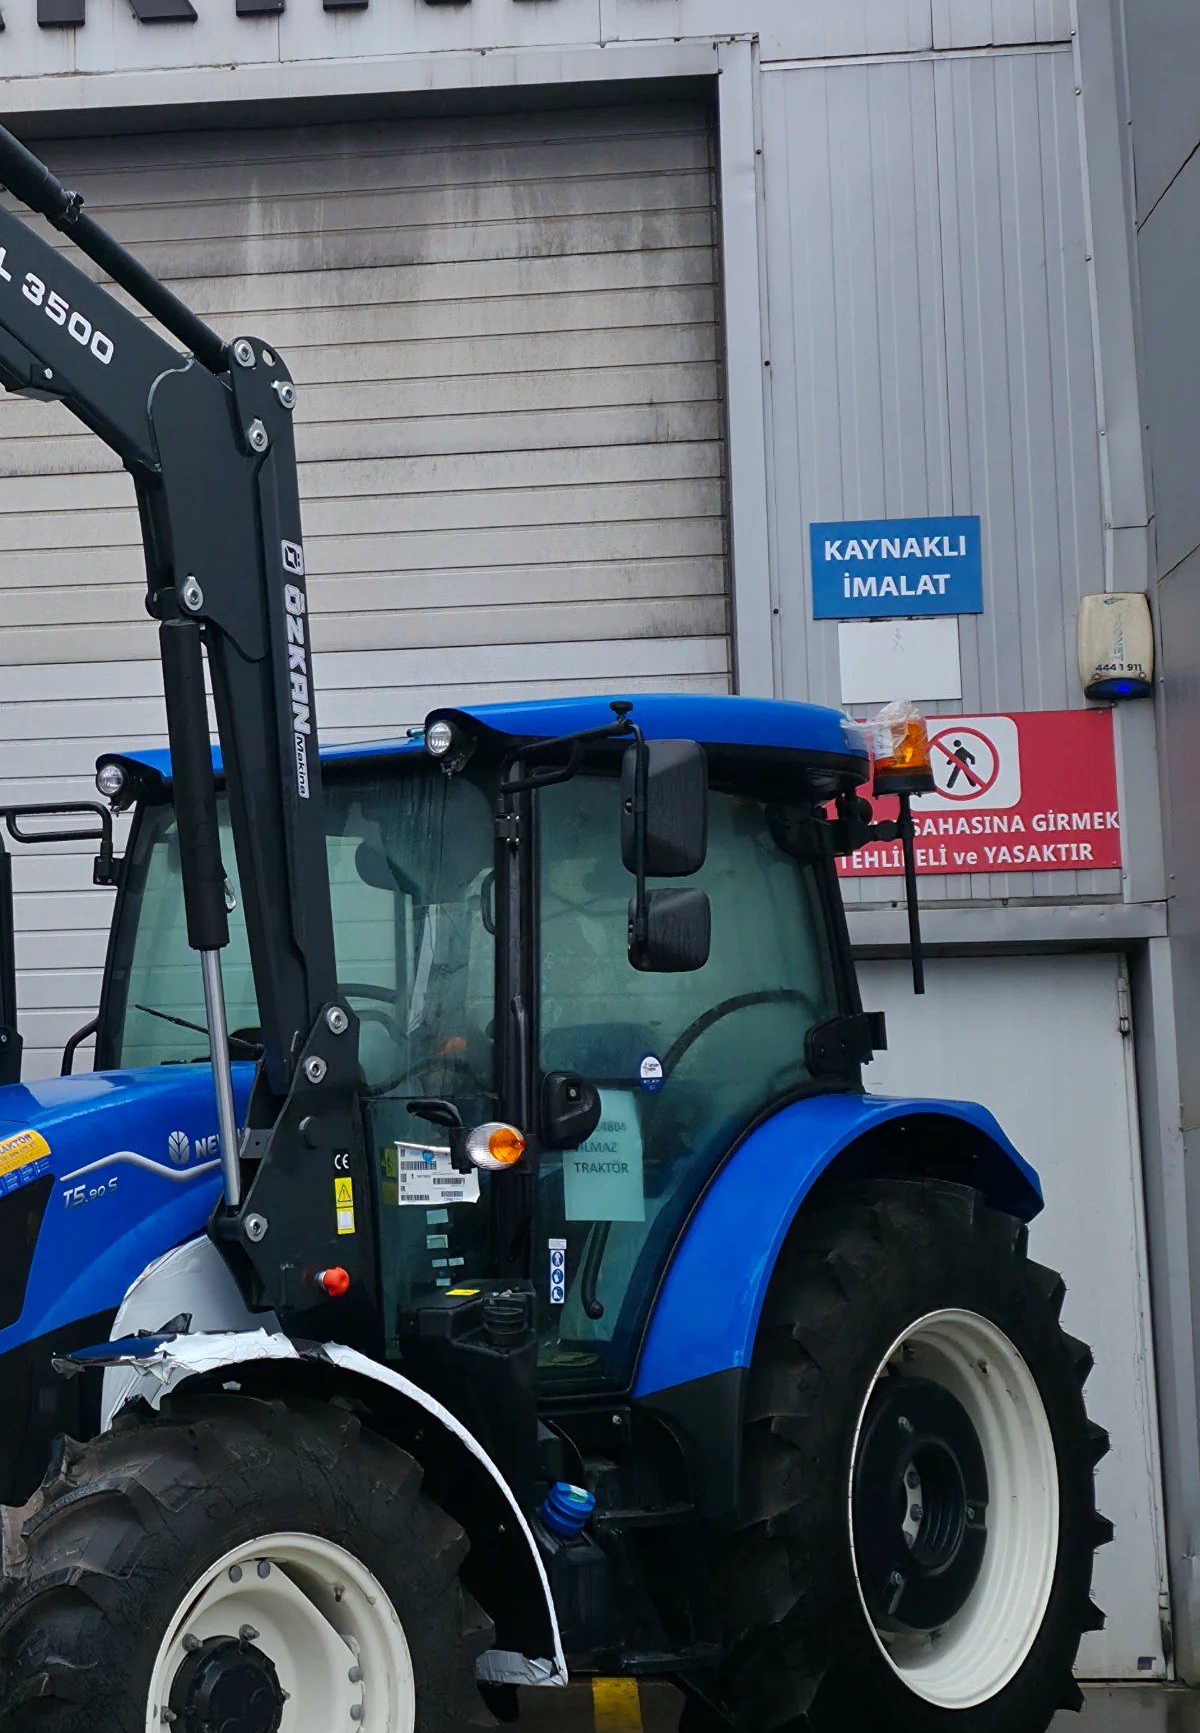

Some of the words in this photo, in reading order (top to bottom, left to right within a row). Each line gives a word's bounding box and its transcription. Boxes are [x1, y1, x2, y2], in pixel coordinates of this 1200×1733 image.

[22, 272, 114, 365] 3500
[824, 535, 966, 561] KAYNAKLI
[844, 572, 950, 599] İMALAT
[284, 583, 311, 735] ÖZKAN
[912, 815, 1025, 837] SAHASINA
[1032, 809, 1119, 832] GİRMEK
[841, 844, 947, 869] EHLİELİ
[953, 852, 977, 865] ve
[984, 843, 1093, 864] YASAKTIR
[195, 1134, 220, 1159] NE
[576, 1142, 617, 1153] ILMAZ
[334, 1153, 349, 1169] CE
[574, 1160, 629, 1173] TRAKTÖR
[63, 1184, 105, 1209] T5.90
[108, 1177, 118, 1192] S
